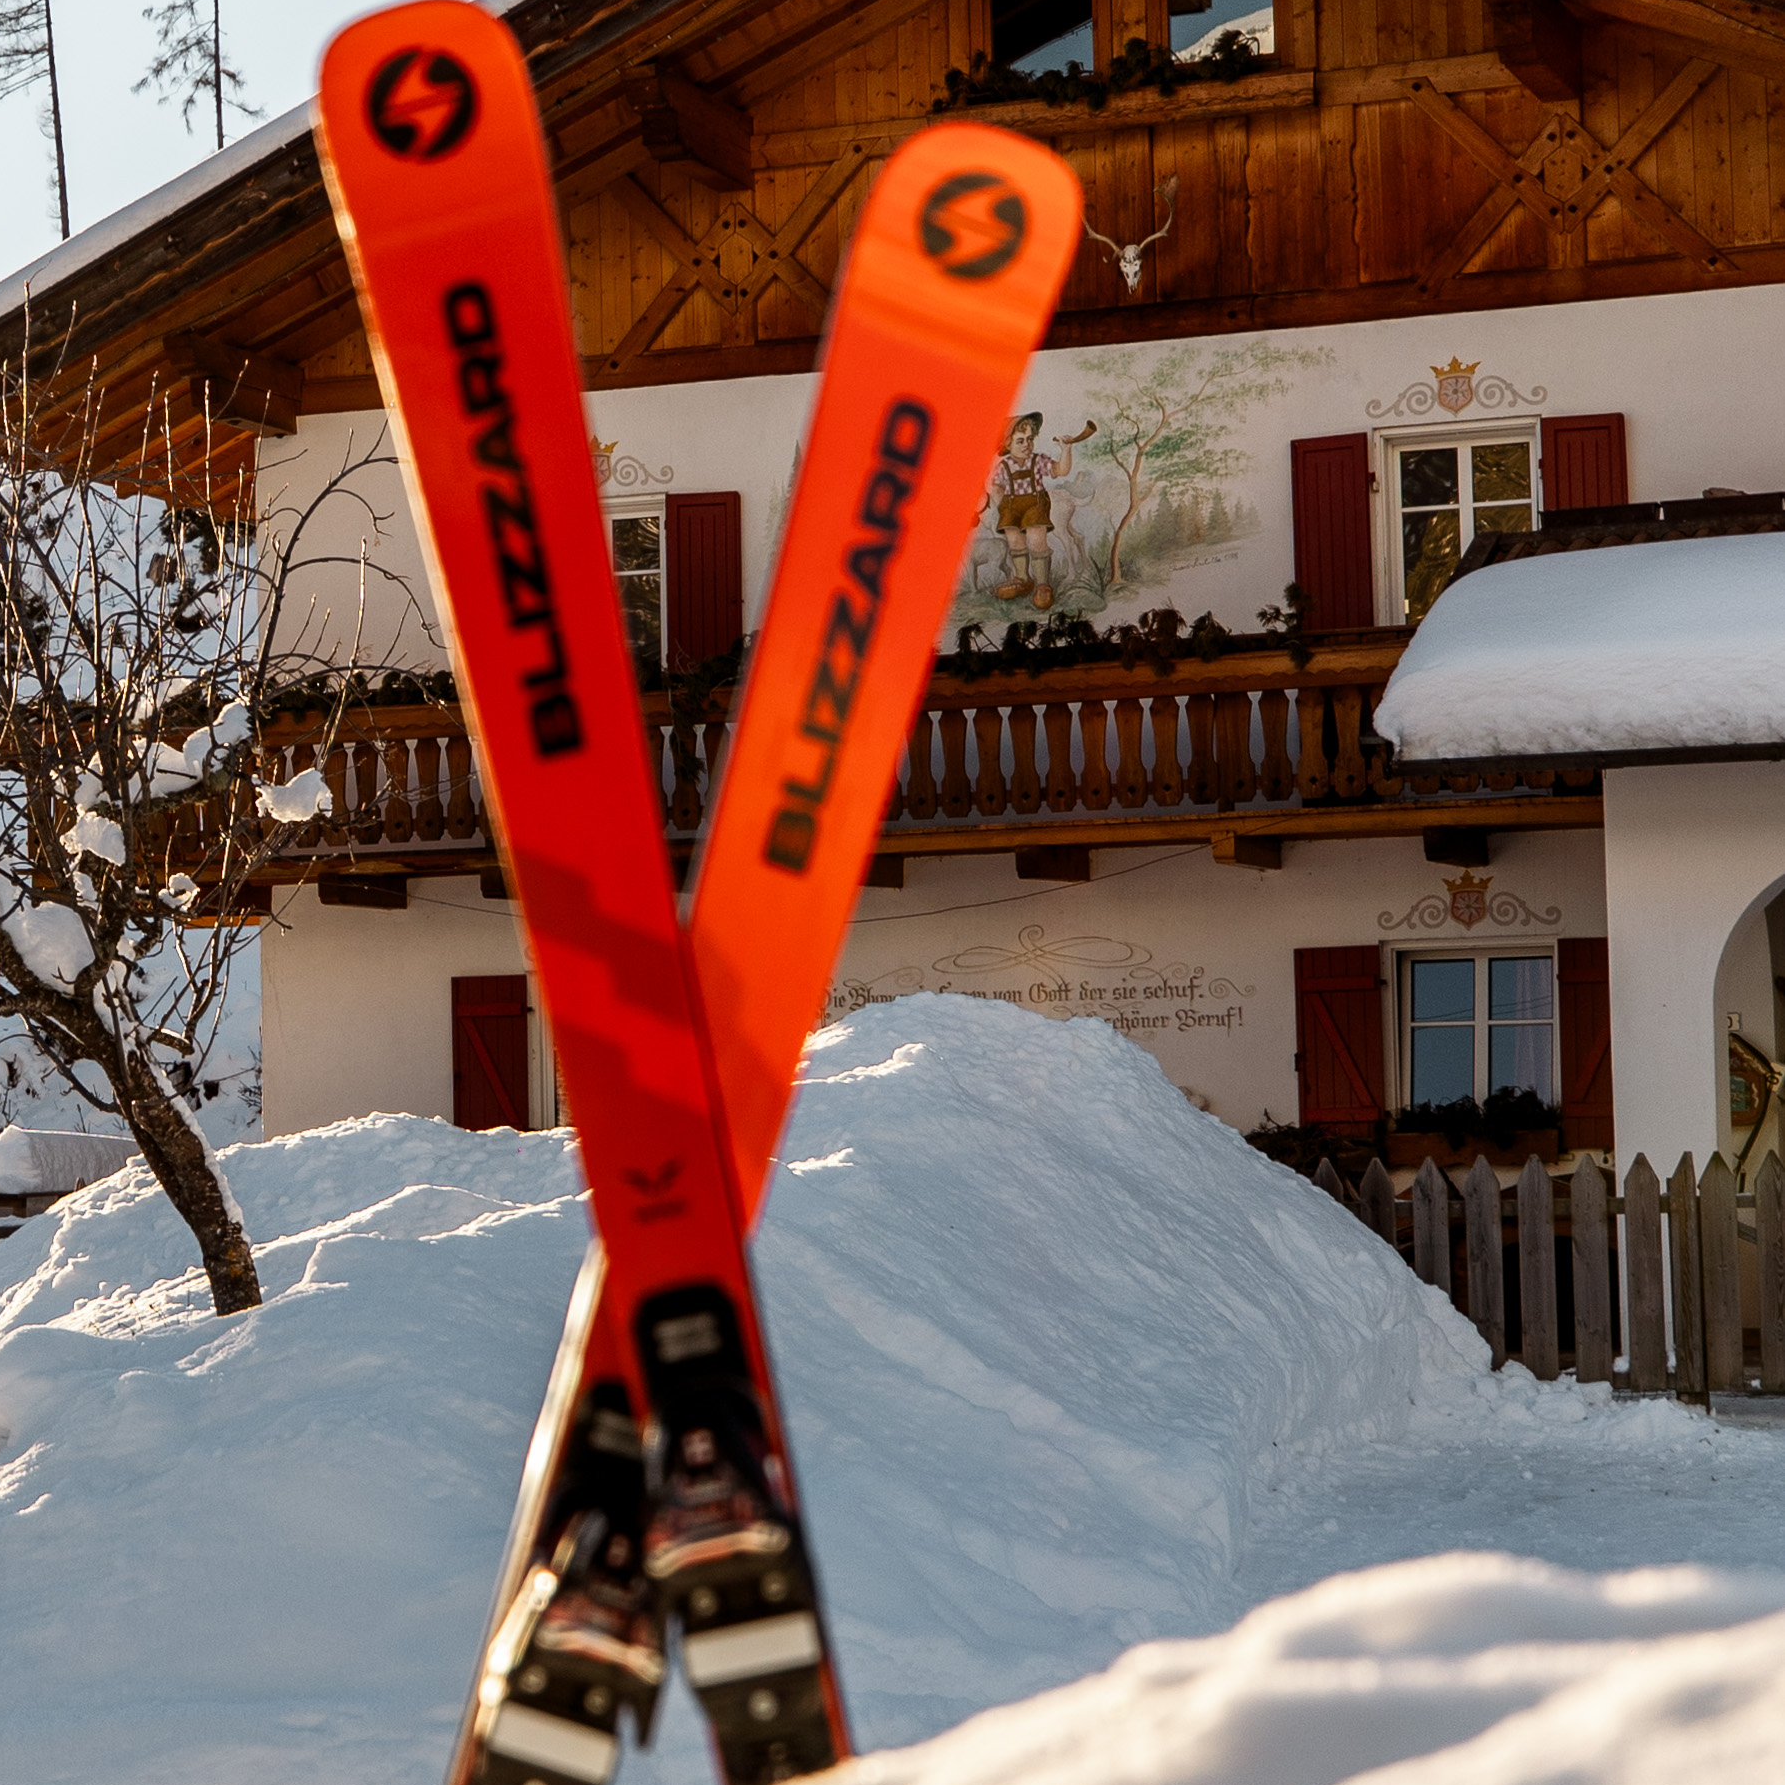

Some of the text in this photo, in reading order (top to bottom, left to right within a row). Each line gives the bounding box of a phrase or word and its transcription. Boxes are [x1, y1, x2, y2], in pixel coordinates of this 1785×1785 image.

[445, 281, 583, 759] BLIZZARD
[764, 397, 934, 875] BLIZZARD
[1028, 980, 1072, 1003] Gott
[1079, 980, 1107, 1002] der
[1112, 978, 1137, 1000] sie
[1175, 1006, 1244, 1037] Beruf!
